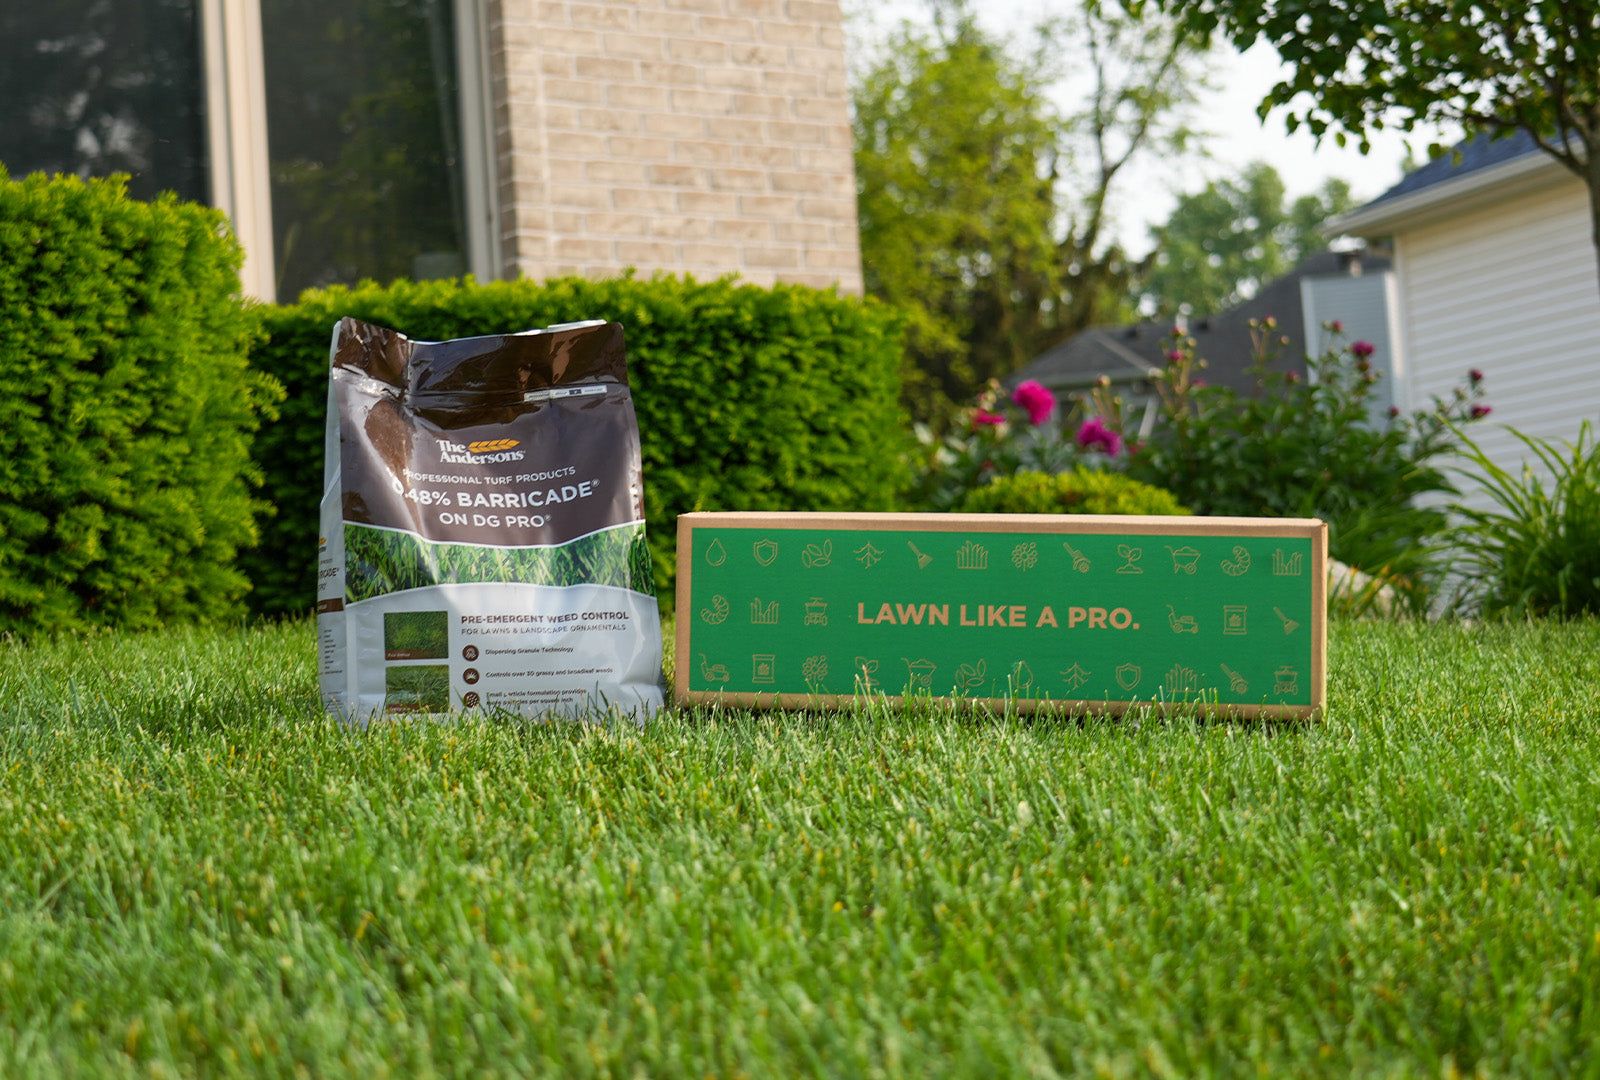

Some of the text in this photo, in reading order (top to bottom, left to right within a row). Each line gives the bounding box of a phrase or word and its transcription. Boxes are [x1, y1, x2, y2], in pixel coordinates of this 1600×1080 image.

[436, 440, 466, 453] The
[440, 449, 524, 464] Andersons
[484, 475, 512, 485] TURF
[515, 466, 576, 483] PRODUCTS
[392, 477, 451, 506] 0.48%
[439, 512, 468, 525] ON
[473, 514, 500, 527] DG
[461, 611, 629, 624] PRE-EMERGENT WEED CONTROL
[857, 602, 1140, 630] LAWN LIKE A PRO.
[481, 627, 511, 635] LAWNS
[520, 626, 569, 634] LANDSCAPE
[570, 624, 627, 632] ORNAMENTALS
[485, 647, 516, 655] Dispersing
